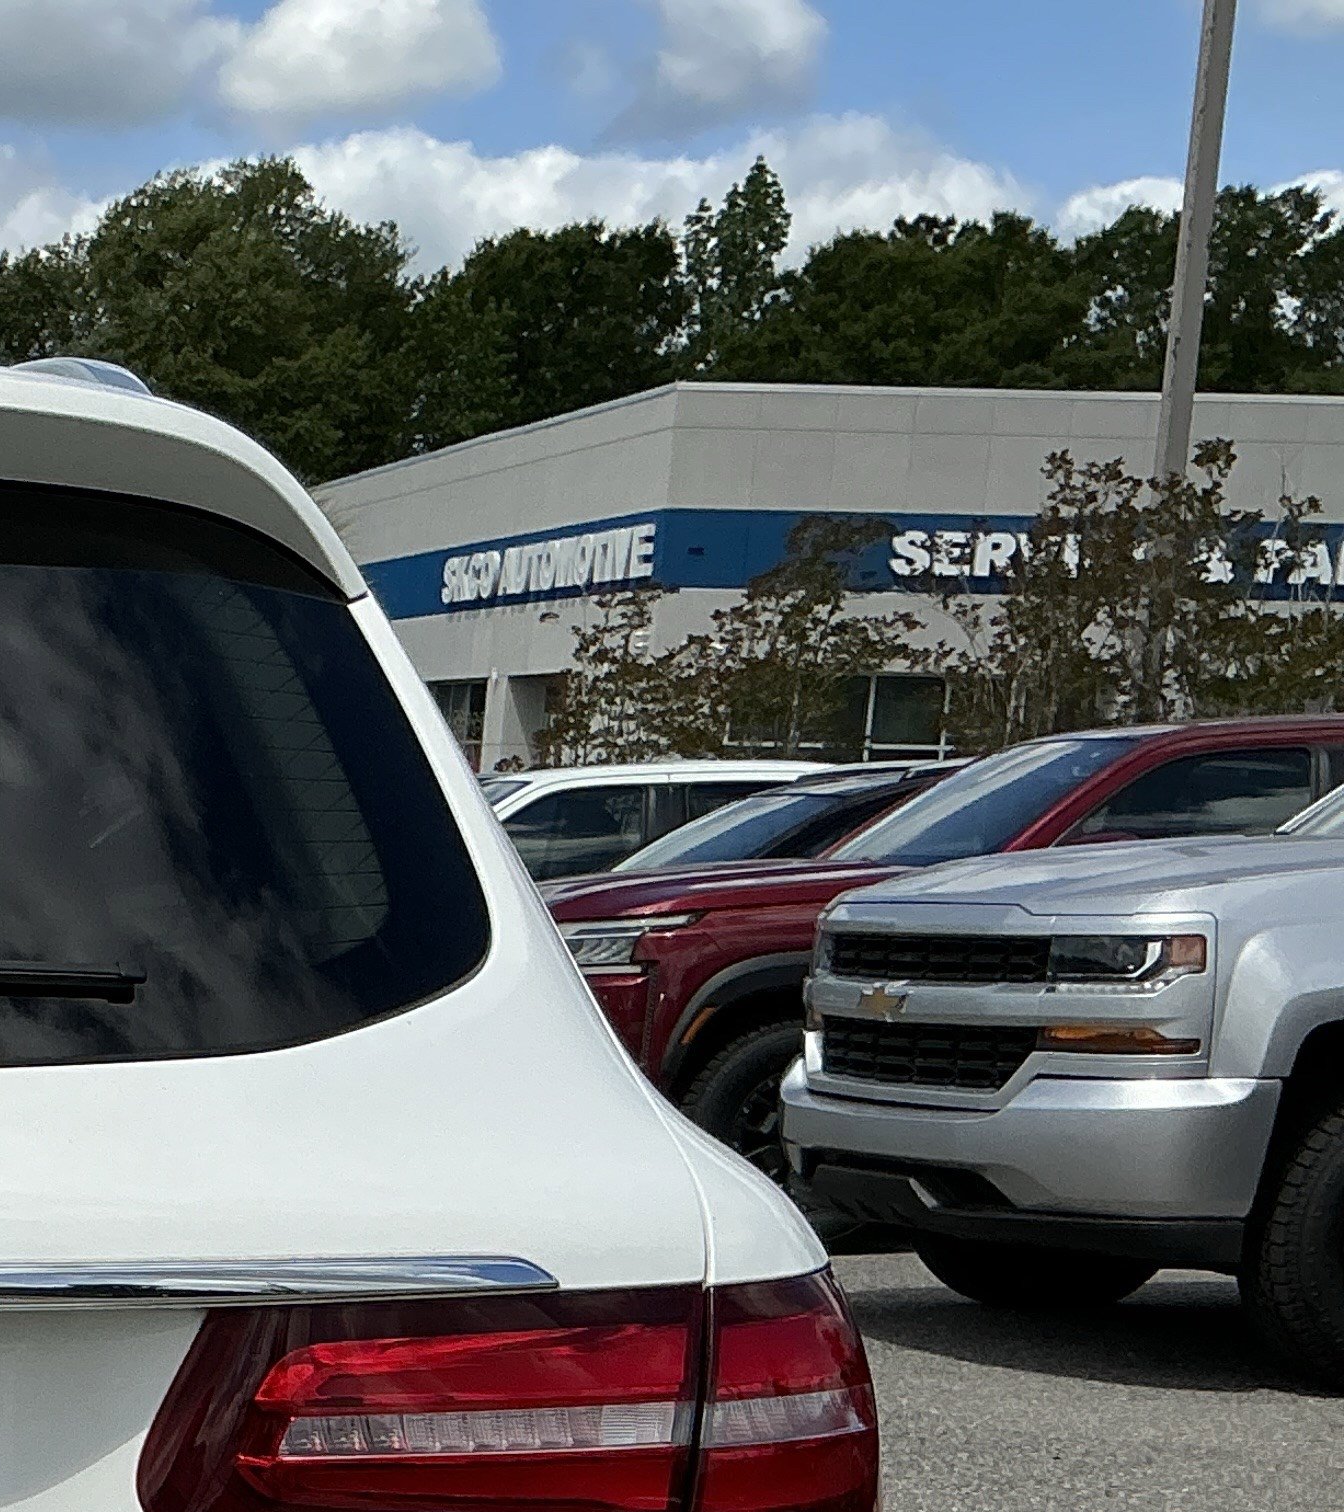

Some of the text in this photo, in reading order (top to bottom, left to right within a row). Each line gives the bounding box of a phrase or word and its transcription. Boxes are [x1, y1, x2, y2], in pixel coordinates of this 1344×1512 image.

[441, 523, 657, 605] SKCO AUTOMOTIVE
[888, 530, 1154, 580] SERVI
[1253, 538, 1344, 586] PA
